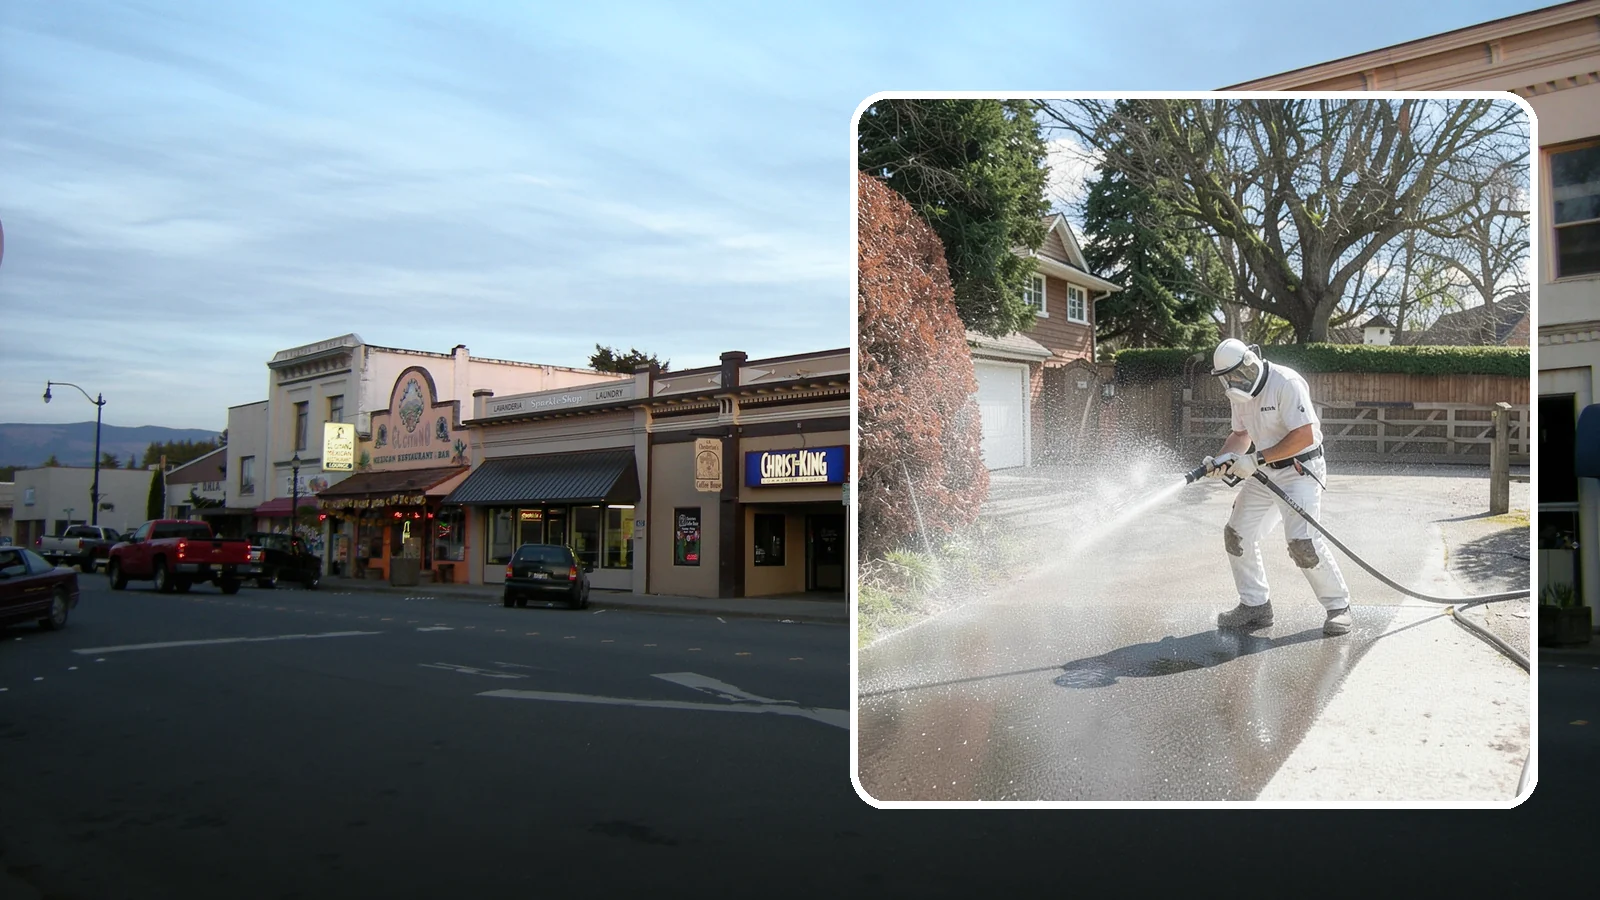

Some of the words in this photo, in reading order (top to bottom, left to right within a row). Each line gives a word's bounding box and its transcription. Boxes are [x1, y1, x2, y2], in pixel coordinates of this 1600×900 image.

[493, 402, 523, 412] LAVANDERIA
[531, 397, 560, 409] Sparkle
[561, 394, 582, 405] Shop
[595, 389, 624, 400] LAUNDRY
[373, 455, 396, 464] MEXICAN
[397, 451, 433, 462] RESTAURANT
[438, 450, 450, 459] BAR
[799, 450, 828, 476] KING
